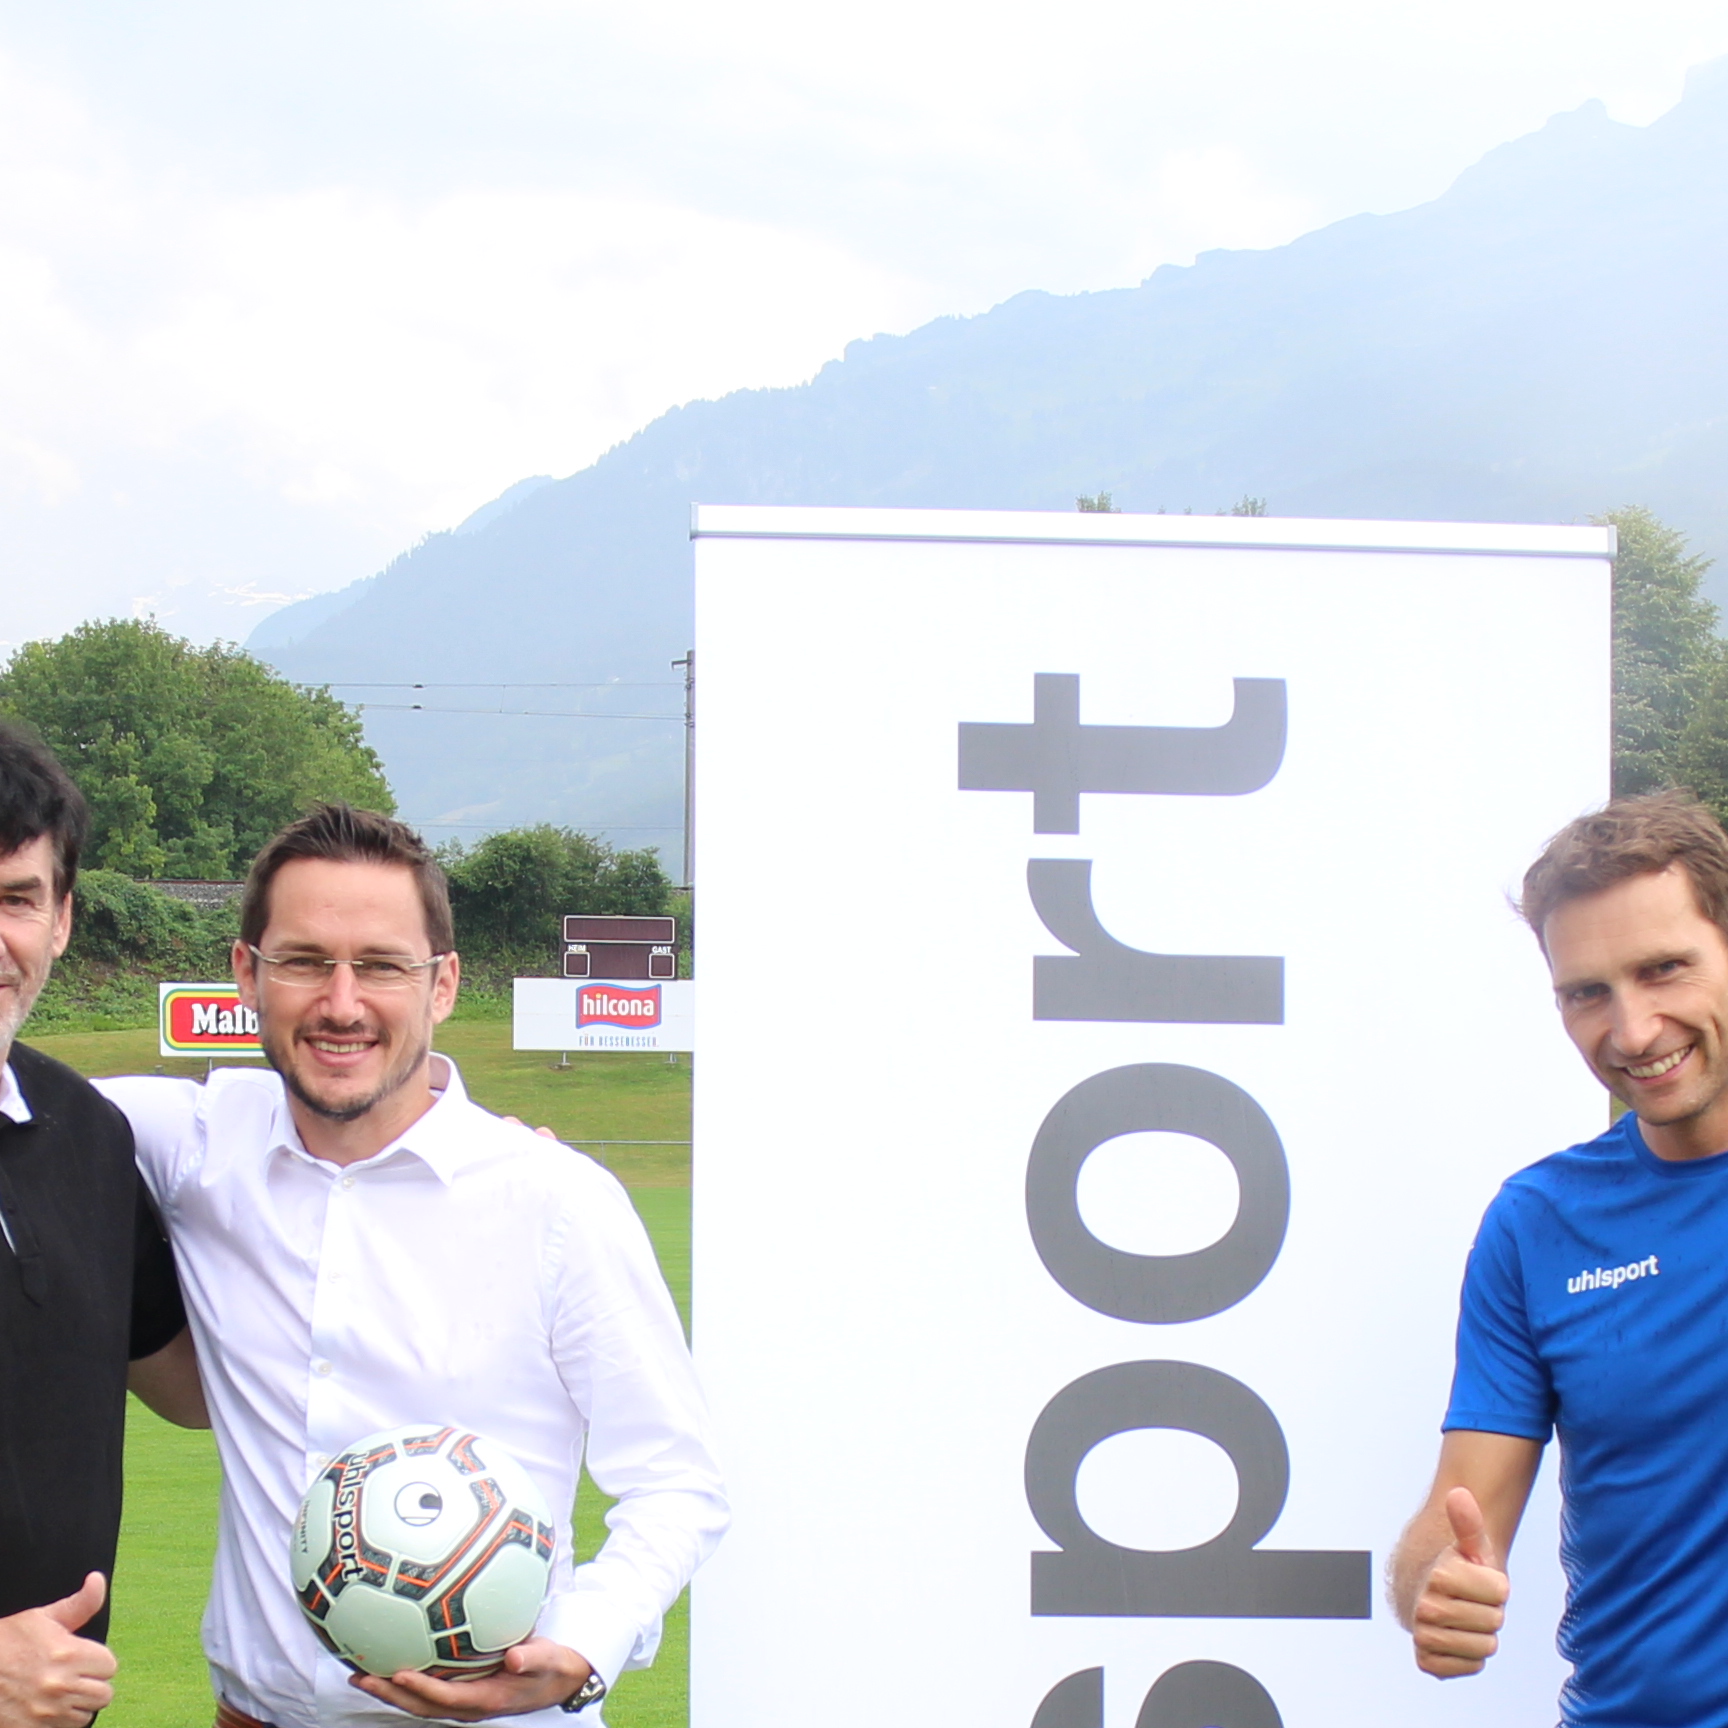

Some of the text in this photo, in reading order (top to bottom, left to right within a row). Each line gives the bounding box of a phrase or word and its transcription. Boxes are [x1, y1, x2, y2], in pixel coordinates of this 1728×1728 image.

[652, 945, 672, 954] GAST
[582, 992, 655, 1016] hilcona
[1567, 1254, 1660, 1294] uhlsport
[332, 1451, 369, 1581] uhlsport
